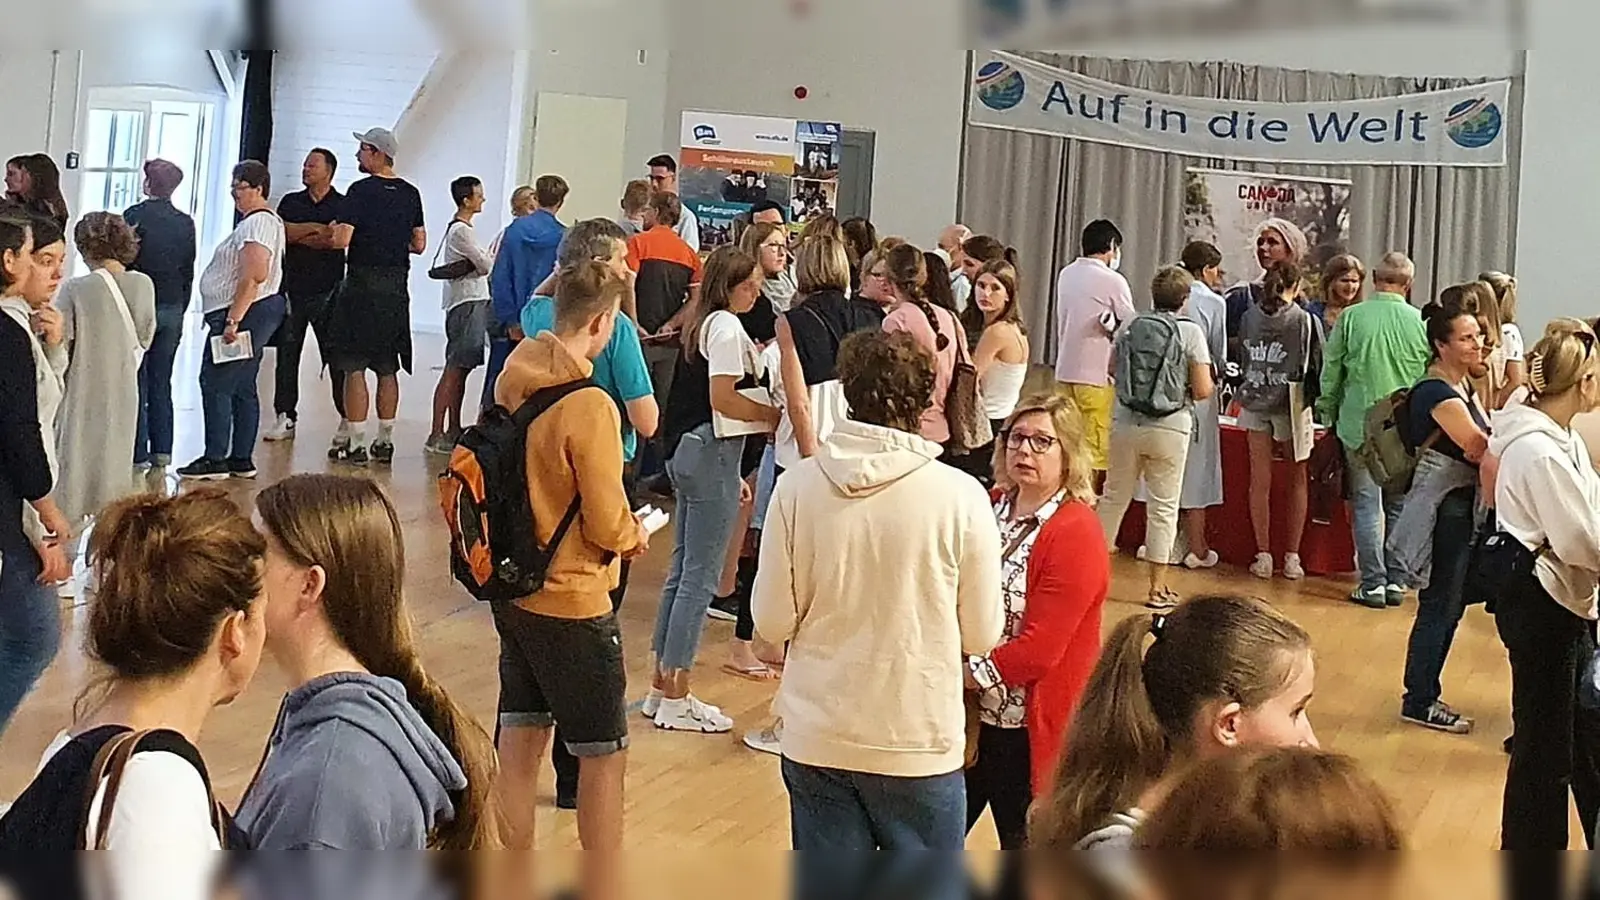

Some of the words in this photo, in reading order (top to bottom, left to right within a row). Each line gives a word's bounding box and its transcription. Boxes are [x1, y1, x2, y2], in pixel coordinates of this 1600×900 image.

[1040, 80, 1128, 124] Auf
[1144, 99, 1188, 133] in
[1206, 110, 1289, 143] die
[1307, 108, 1429, 143] Welt
